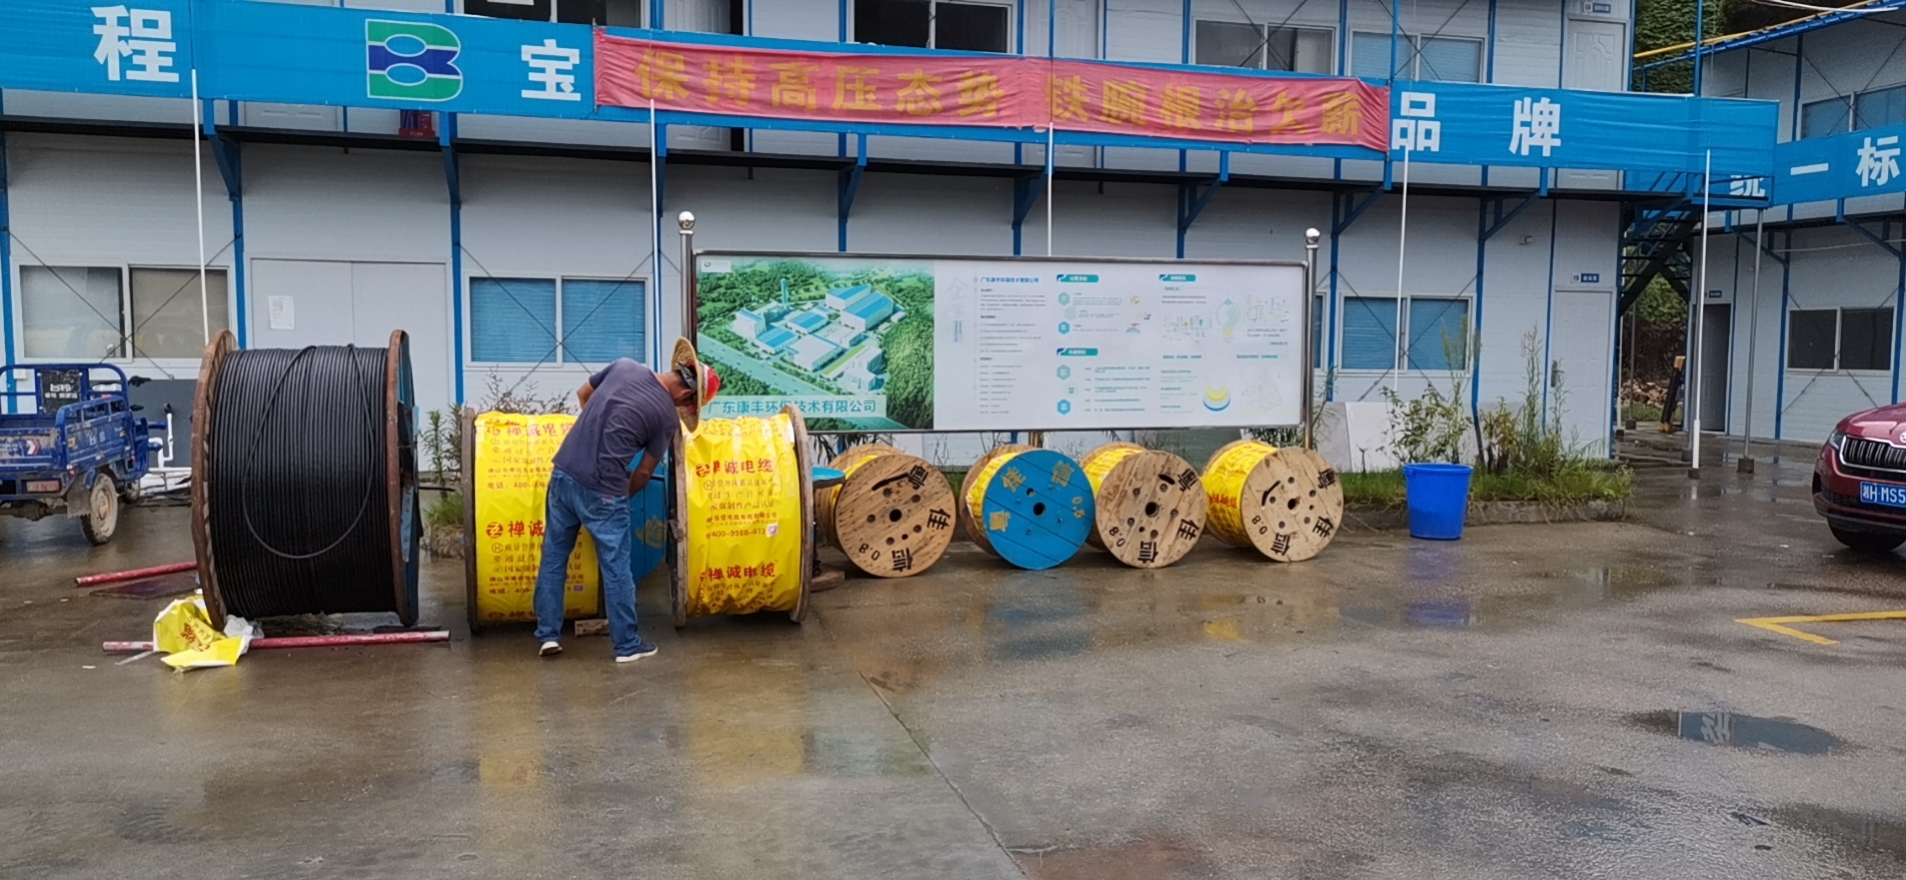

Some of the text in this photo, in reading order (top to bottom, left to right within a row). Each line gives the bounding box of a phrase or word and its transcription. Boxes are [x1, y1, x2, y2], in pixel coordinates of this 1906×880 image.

[92, 5, 180, 82] 程
[521, 39, 582, 101] 宝
[635, 48, 1363, 136] 保持高压态势 铁腕根治欠薪
[1391, 91, 1562, 157] 品 牌
[1855, 135, 1901, 188] 标
